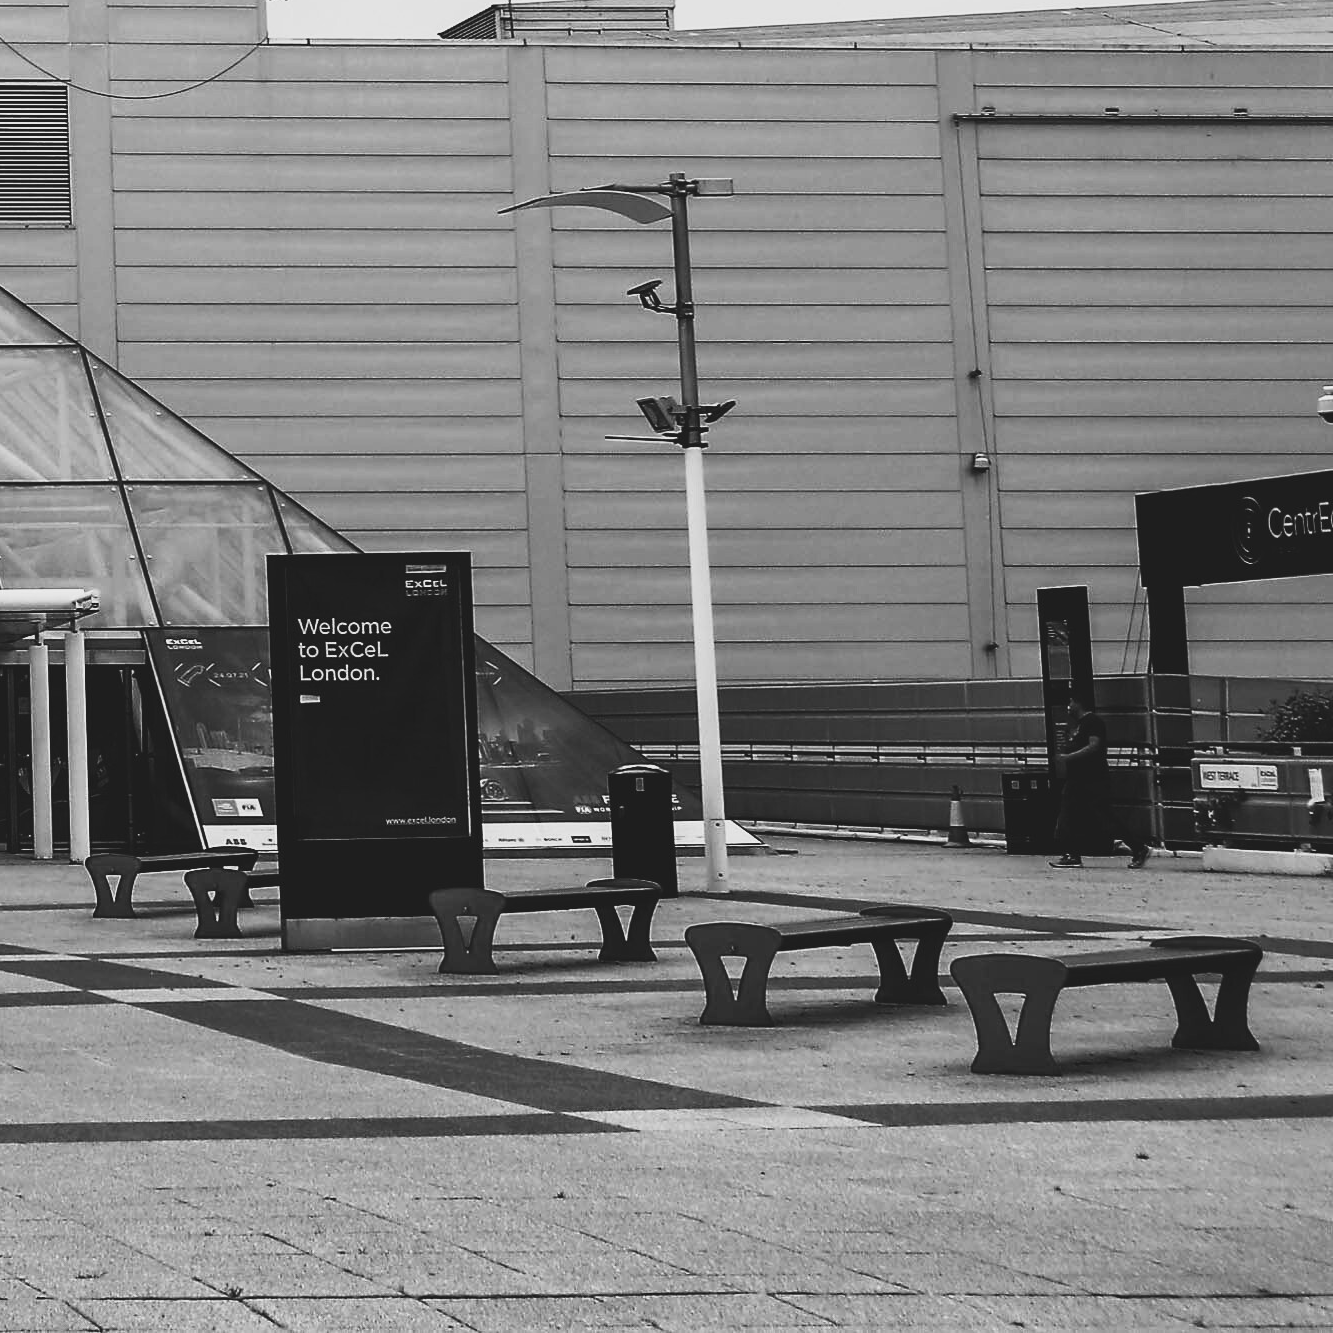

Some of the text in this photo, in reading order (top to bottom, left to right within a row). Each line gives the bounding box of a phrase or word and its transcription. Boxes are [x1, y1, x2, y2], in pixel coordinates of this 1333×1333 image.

[298, 618, 392, 634] Welcome
[298, 641, 389, 658] to ExCeL
[300, 664, 380, 681] London.
